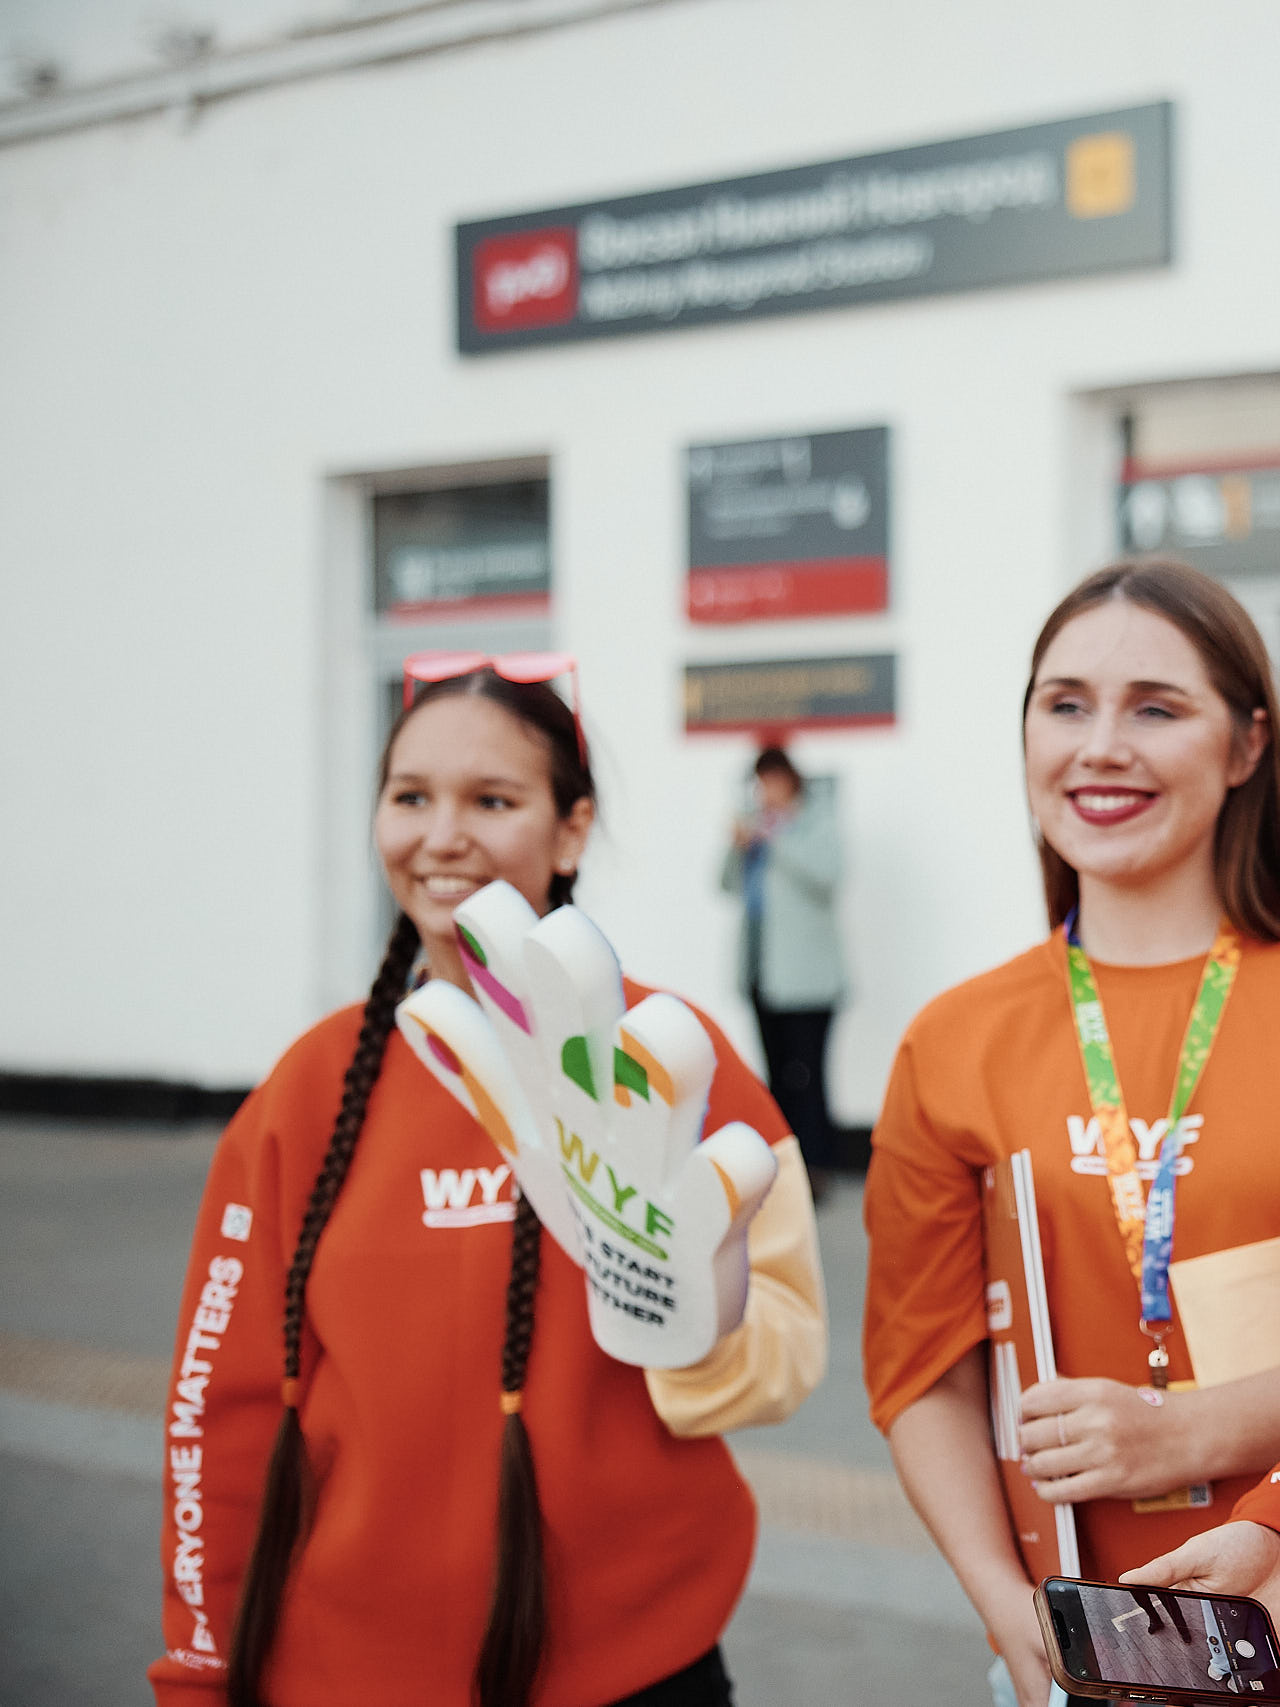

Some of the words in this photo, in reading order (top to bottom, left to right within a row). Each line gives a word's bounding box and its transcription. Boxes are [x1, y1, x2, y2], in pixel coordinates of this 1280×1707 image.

[420, 1164, 519, 1209] WY
[554, 1115, 676, 1238] WYF
[170, 1255, 243, 1437] MATTERS
